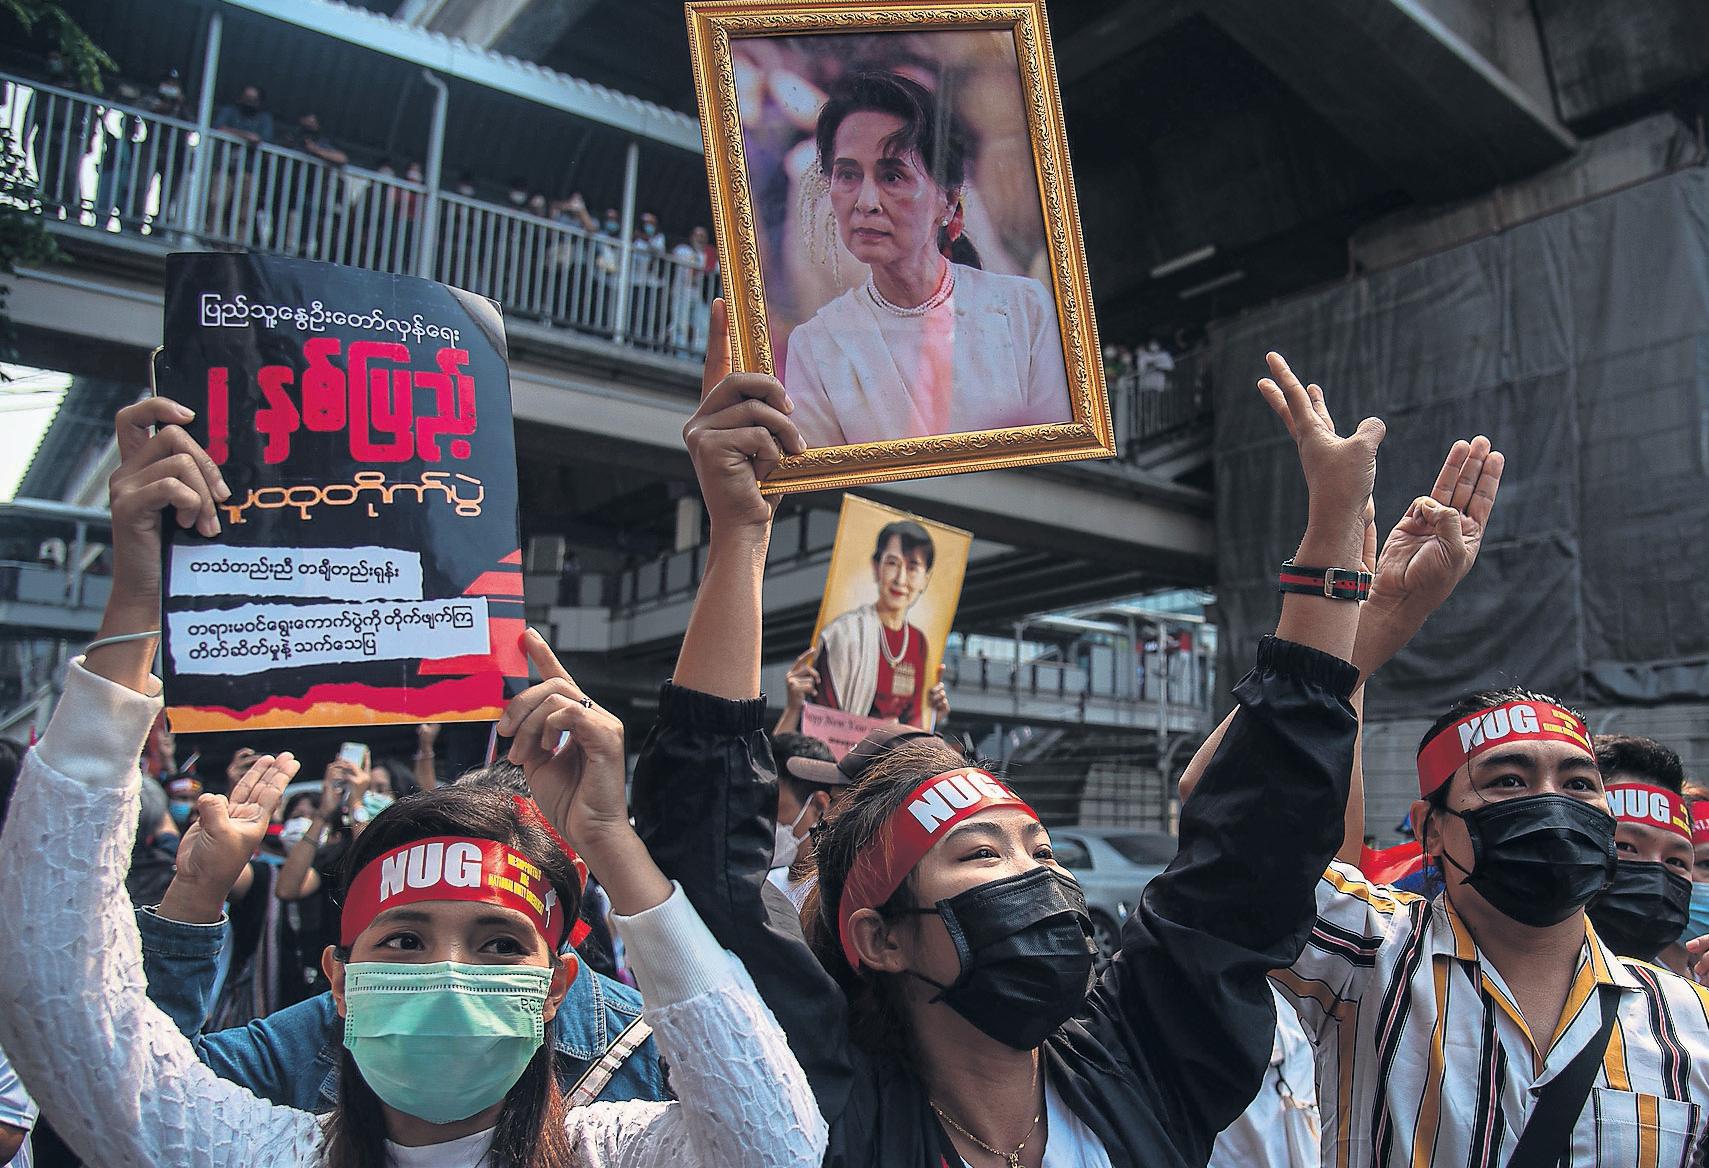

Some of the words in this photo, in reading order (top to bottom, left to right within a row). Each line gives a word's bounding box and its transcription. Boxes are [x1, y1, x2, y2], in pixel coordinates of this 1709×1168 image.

[1458, 704, 1541, 754] NUG
[907, 772, 1013, 834] NUG
[1605, 789, 1671, 824] NUG
[379, 841, 483, 903] NUG
